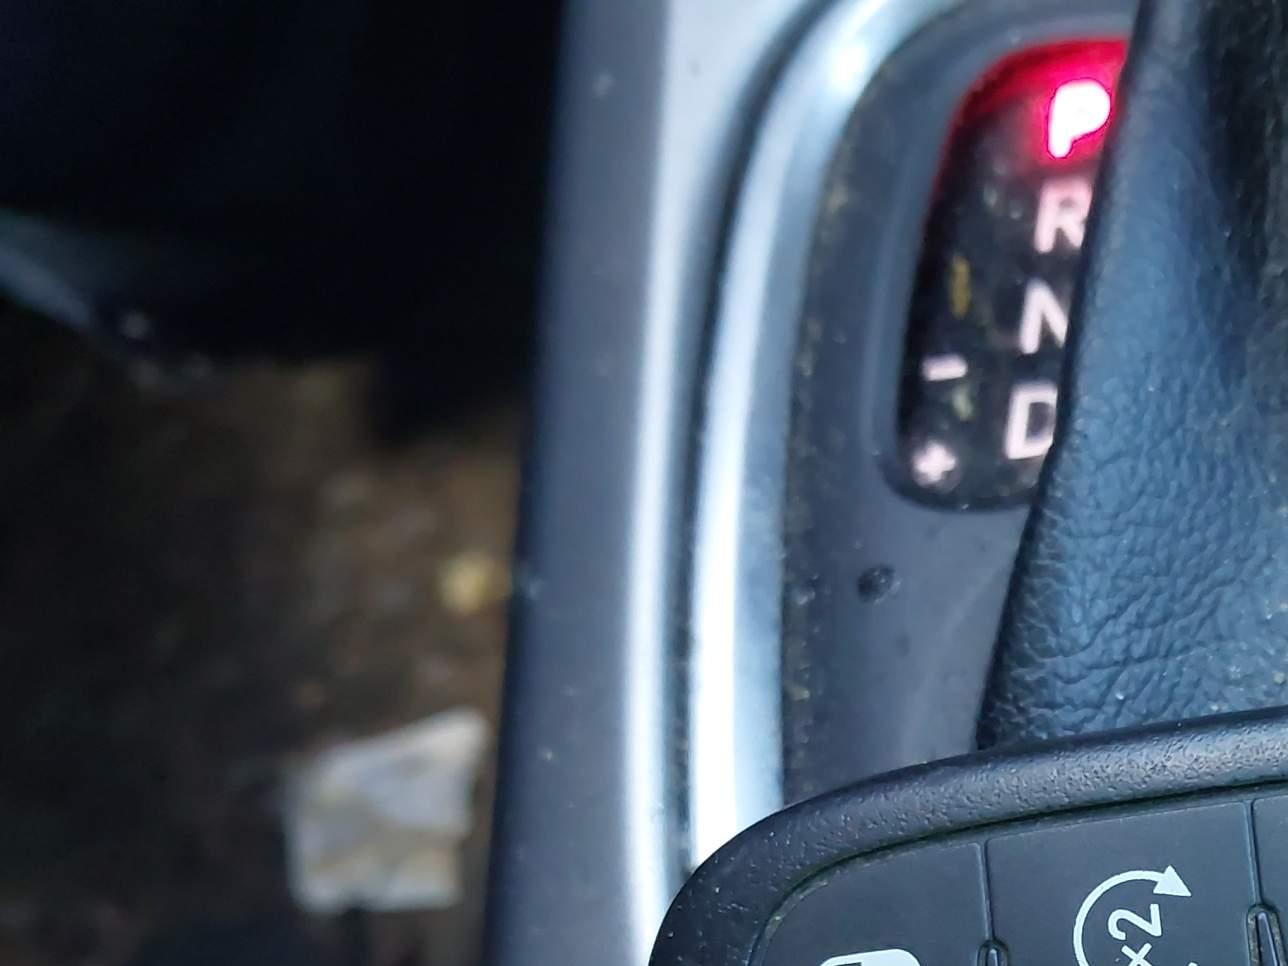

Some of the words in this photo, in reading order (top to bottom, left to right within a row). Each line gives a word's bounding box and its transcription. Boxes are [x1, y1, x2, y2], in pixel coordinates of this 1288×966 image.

[1046, 78, 1112, 160] P
[1034, 176, 1094, 254] R
[1005, 380, 1058, 460] D
